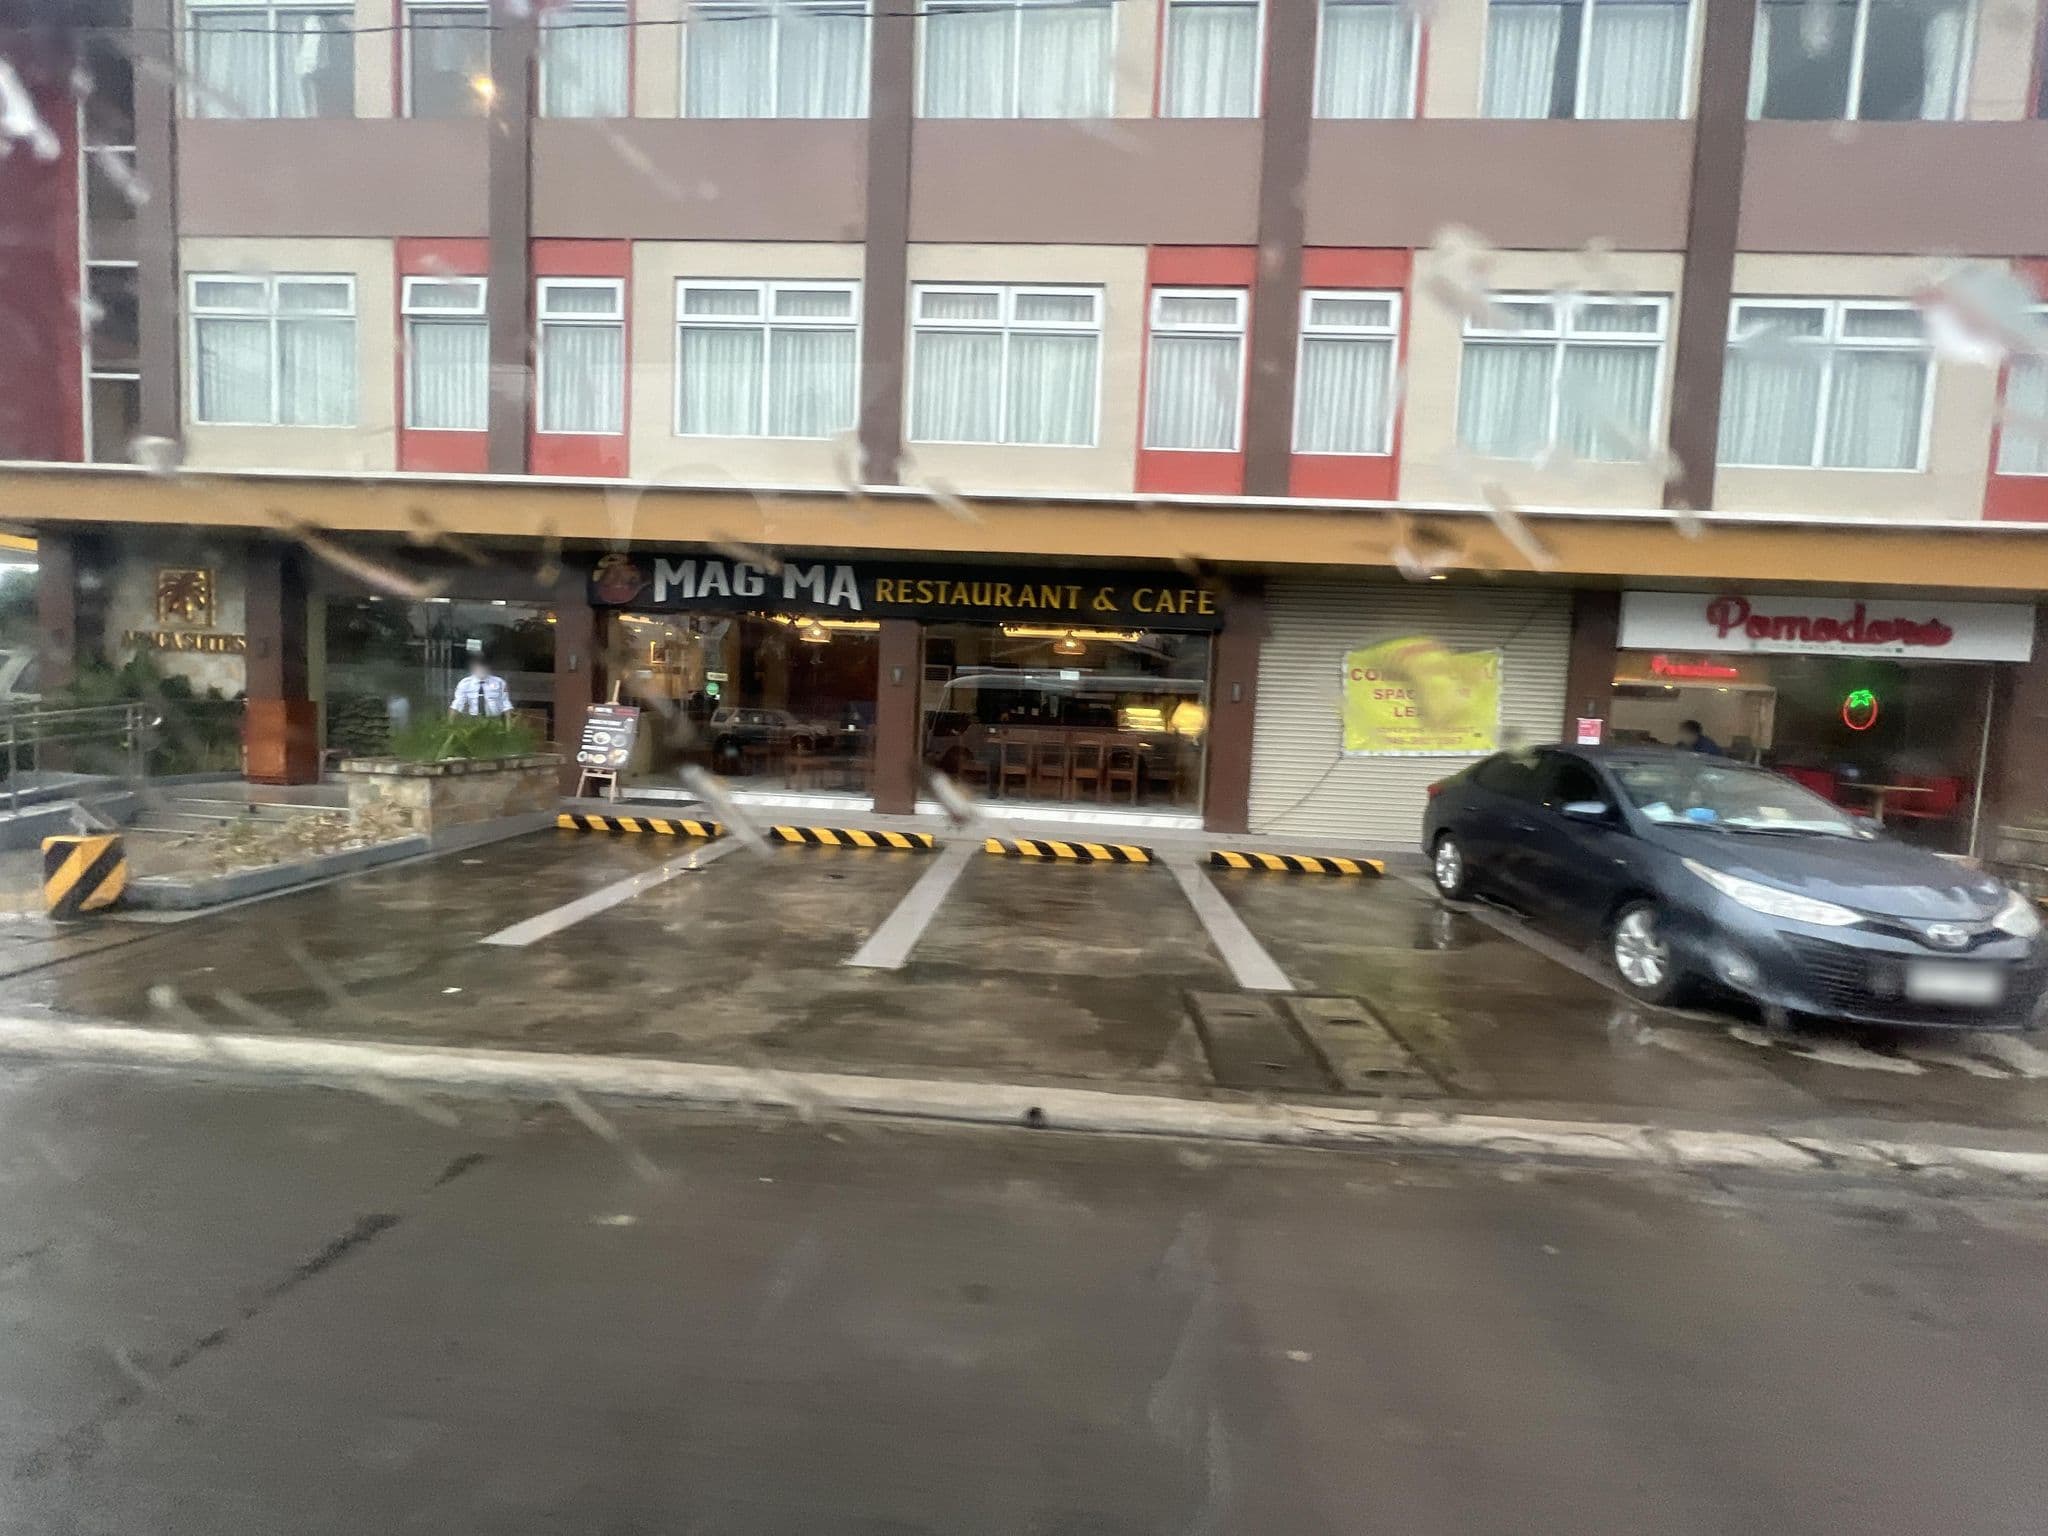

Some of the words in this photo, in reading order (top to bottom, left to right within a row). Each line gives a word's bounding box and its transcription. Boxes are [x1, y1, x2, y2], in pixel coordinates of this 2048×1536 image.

[874, 577, 1082, 610] RESTAURANT
[1092, 587, 1119, 612] &
[1131, 587, 1216, 615] CAFE
